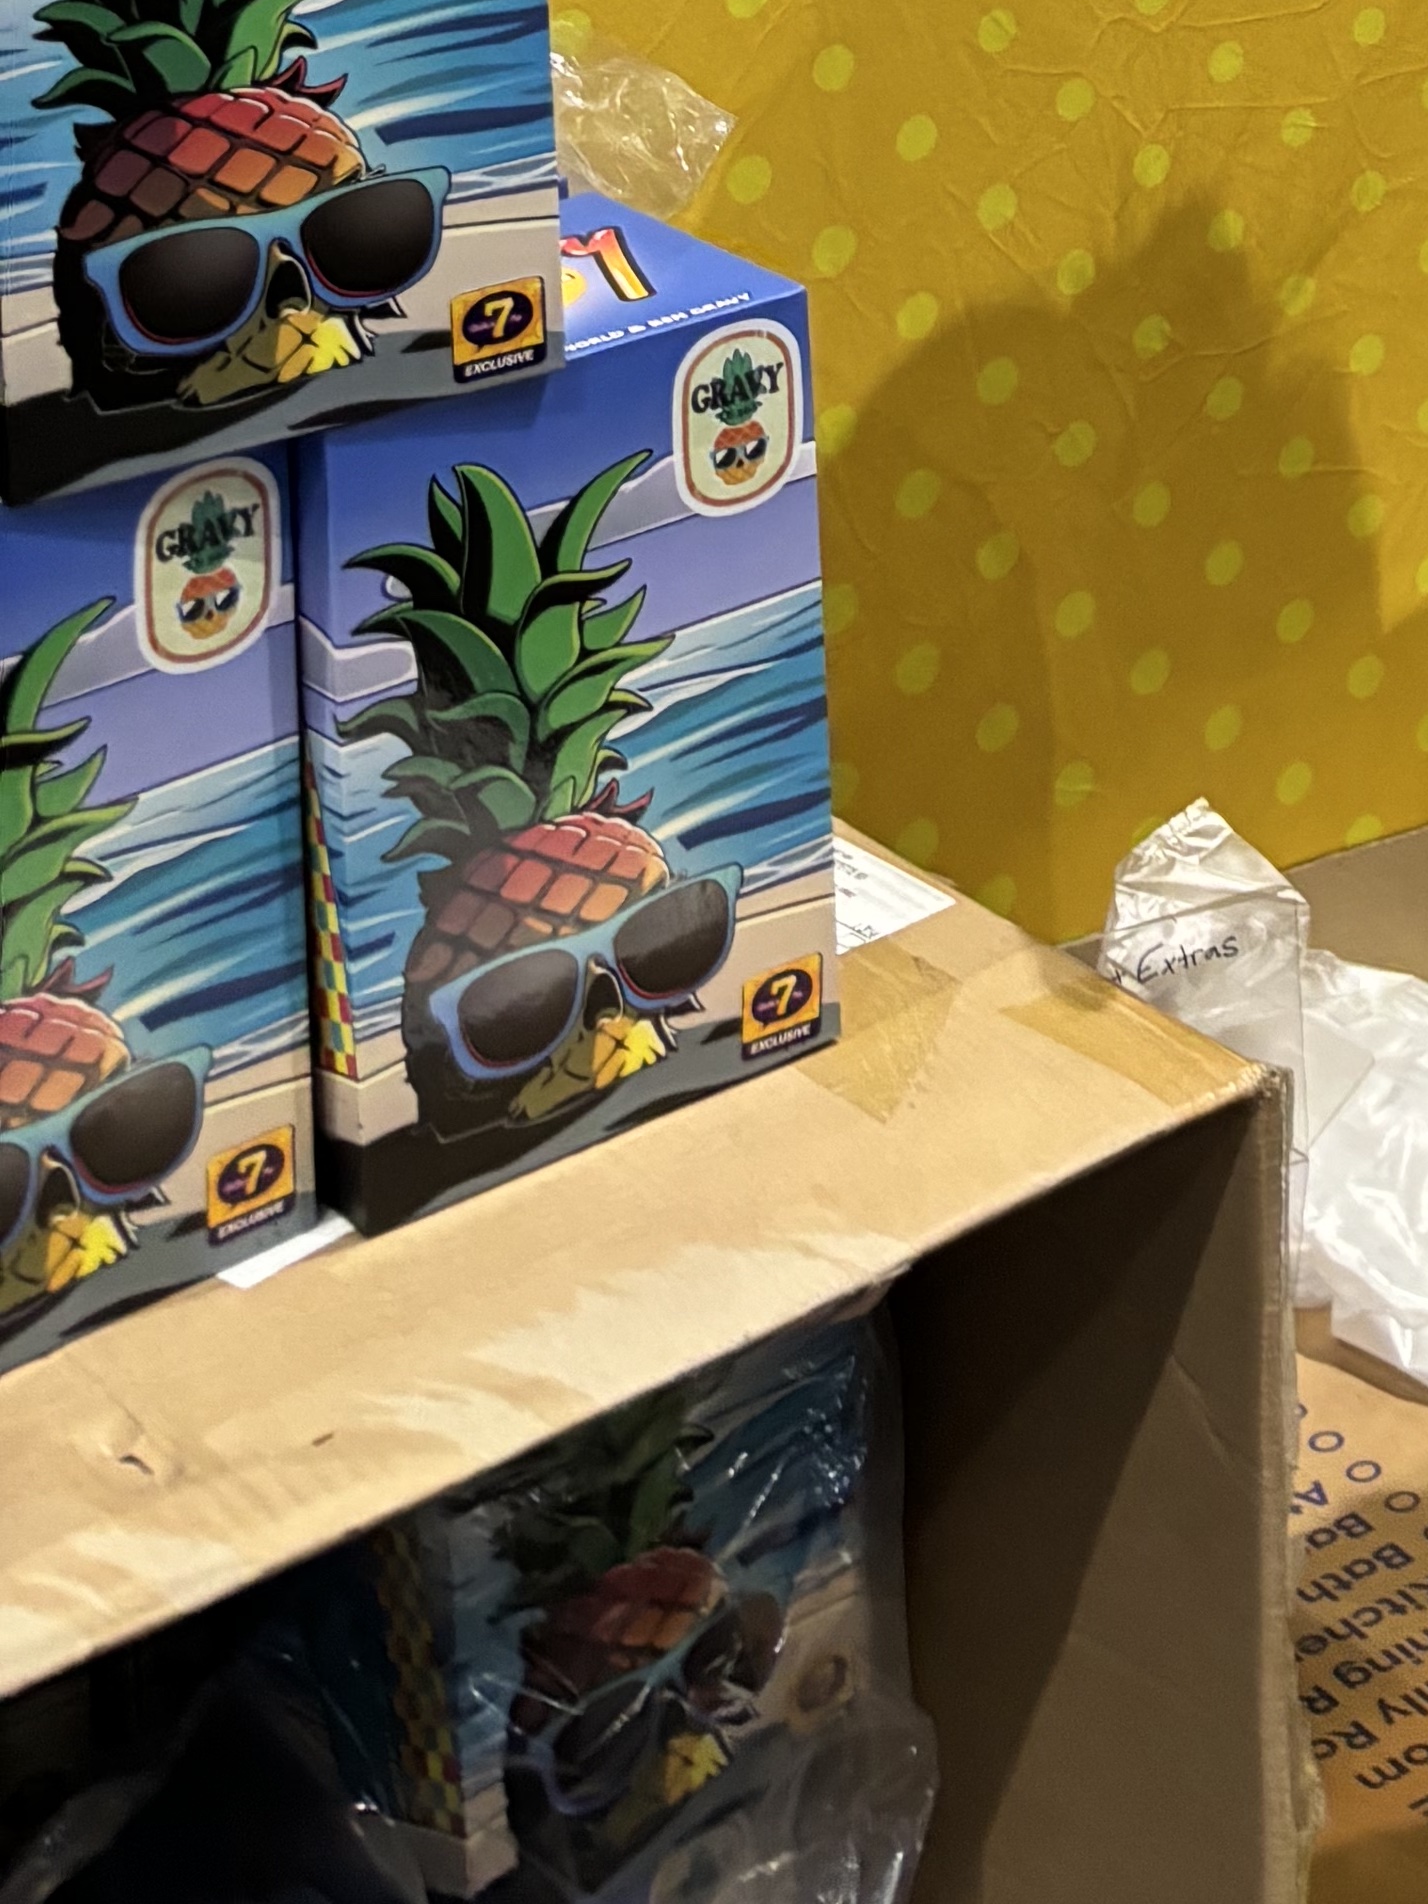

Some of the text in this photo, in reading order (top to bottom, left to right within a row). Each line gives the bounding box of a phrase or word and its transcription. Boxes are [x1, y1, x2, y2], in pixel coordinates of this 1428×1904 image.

[484, 297, 515, 339] 7
[463, 347, 535, 377] EXCLUSIVE
[691, 362, 784, 414] GRAVY
[156, 503, 260, 564] GRAVY
[1136, 935, 1240, 985] Extras
[771, 974, 797, 1017] 7
[750, 1023, 812, 1056] EXCLUSIVE
[238, 1149, 267, 1195] 7
